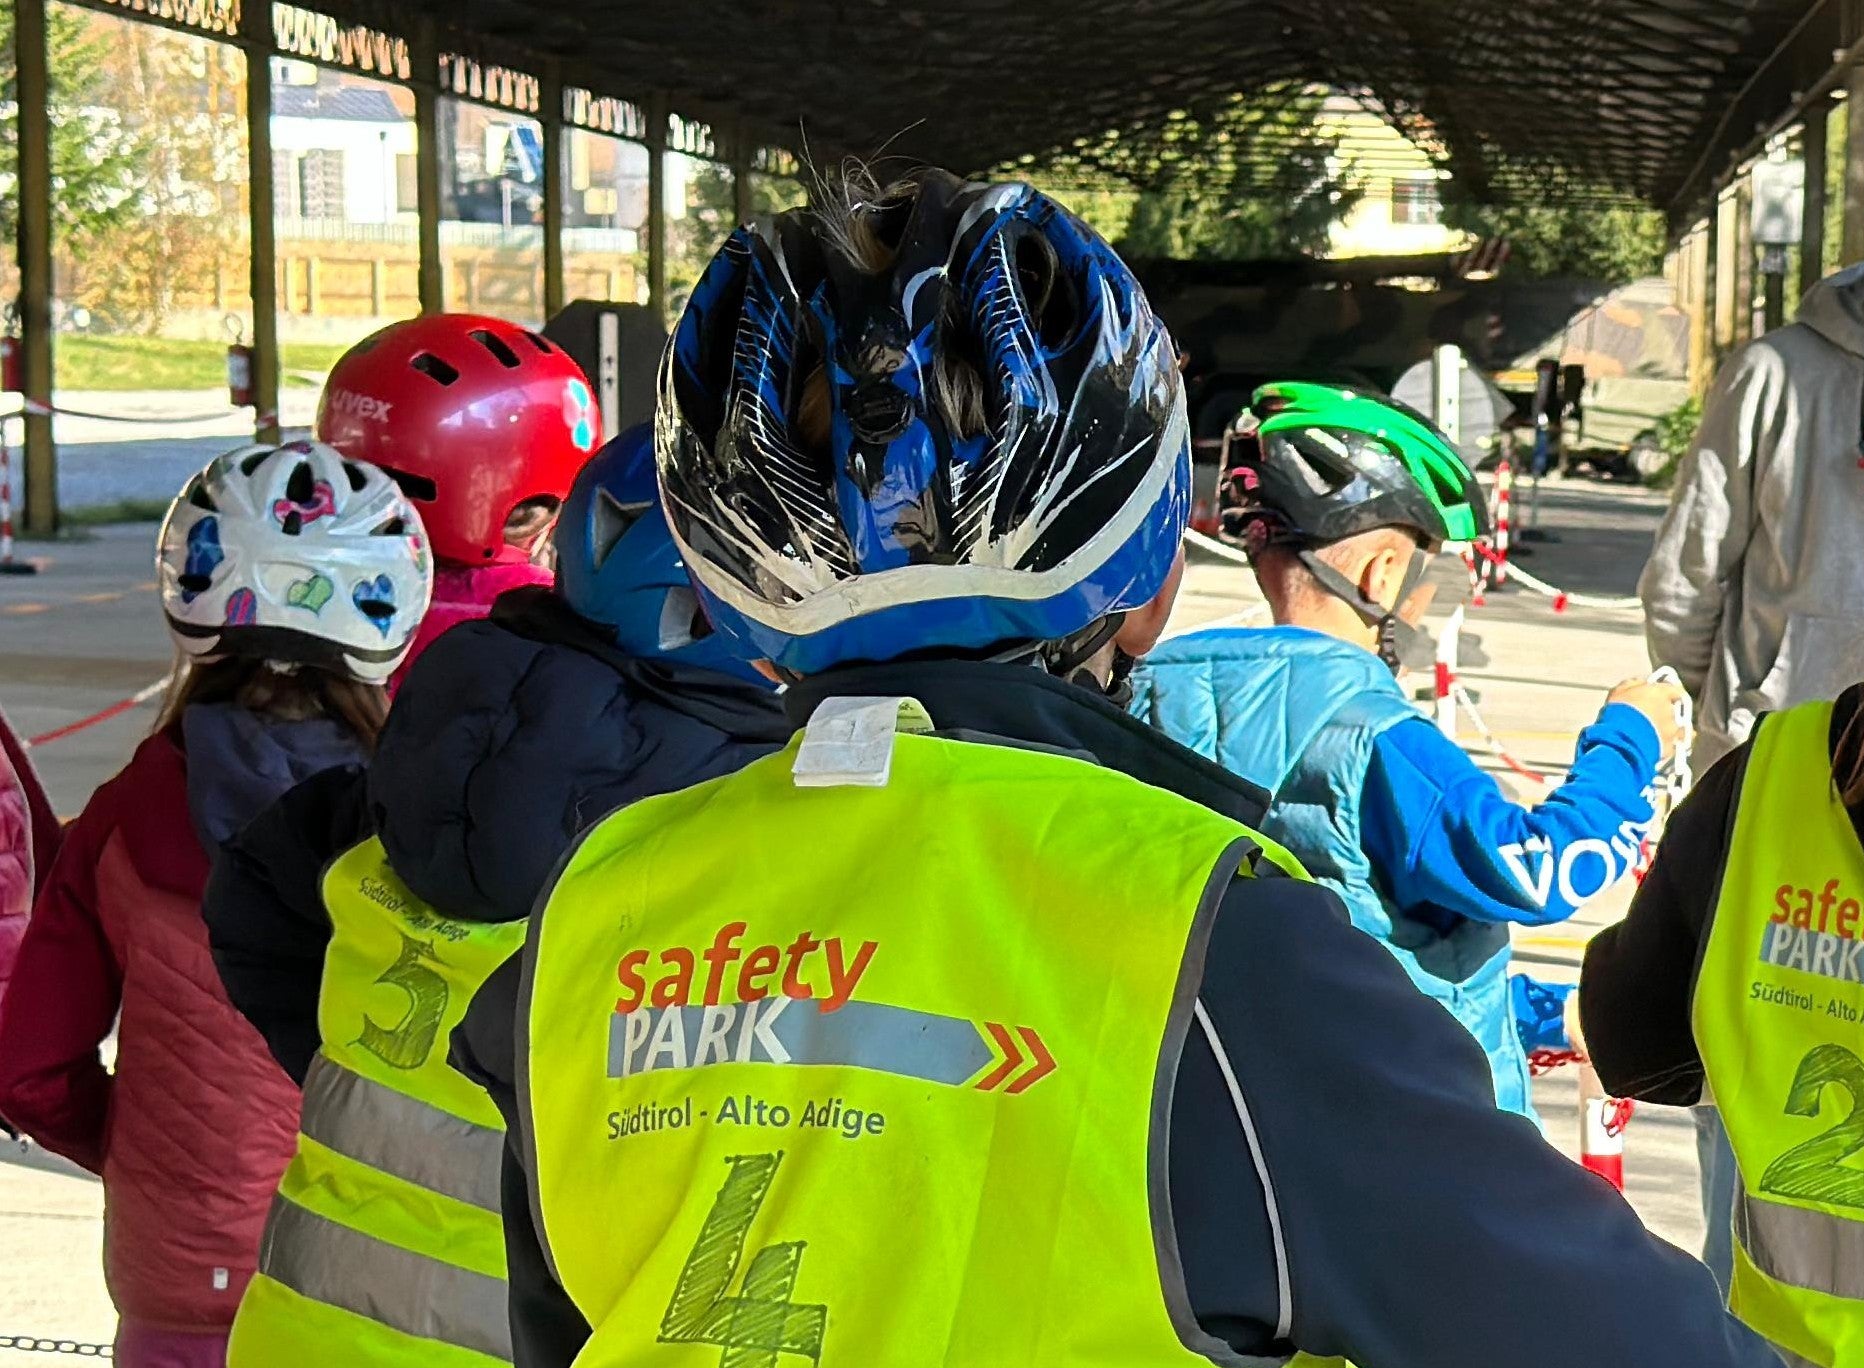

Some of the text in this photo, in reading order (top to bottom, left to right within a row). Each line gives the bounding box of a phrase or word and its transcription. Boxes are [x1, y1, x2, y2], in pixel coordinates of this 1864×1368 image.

[615, 920, 879, 1014] safety
[1748, 981, 1815, 1011] Südtirol
[1826, 997, 1858, 1023] Alto
[621, 994, 793, 1076] PARK
[606, 1095, 692, 1141] Südtirol
[715, 1095, 791, 1128] Alto
[798, 1097, 887, 1139] Adige
